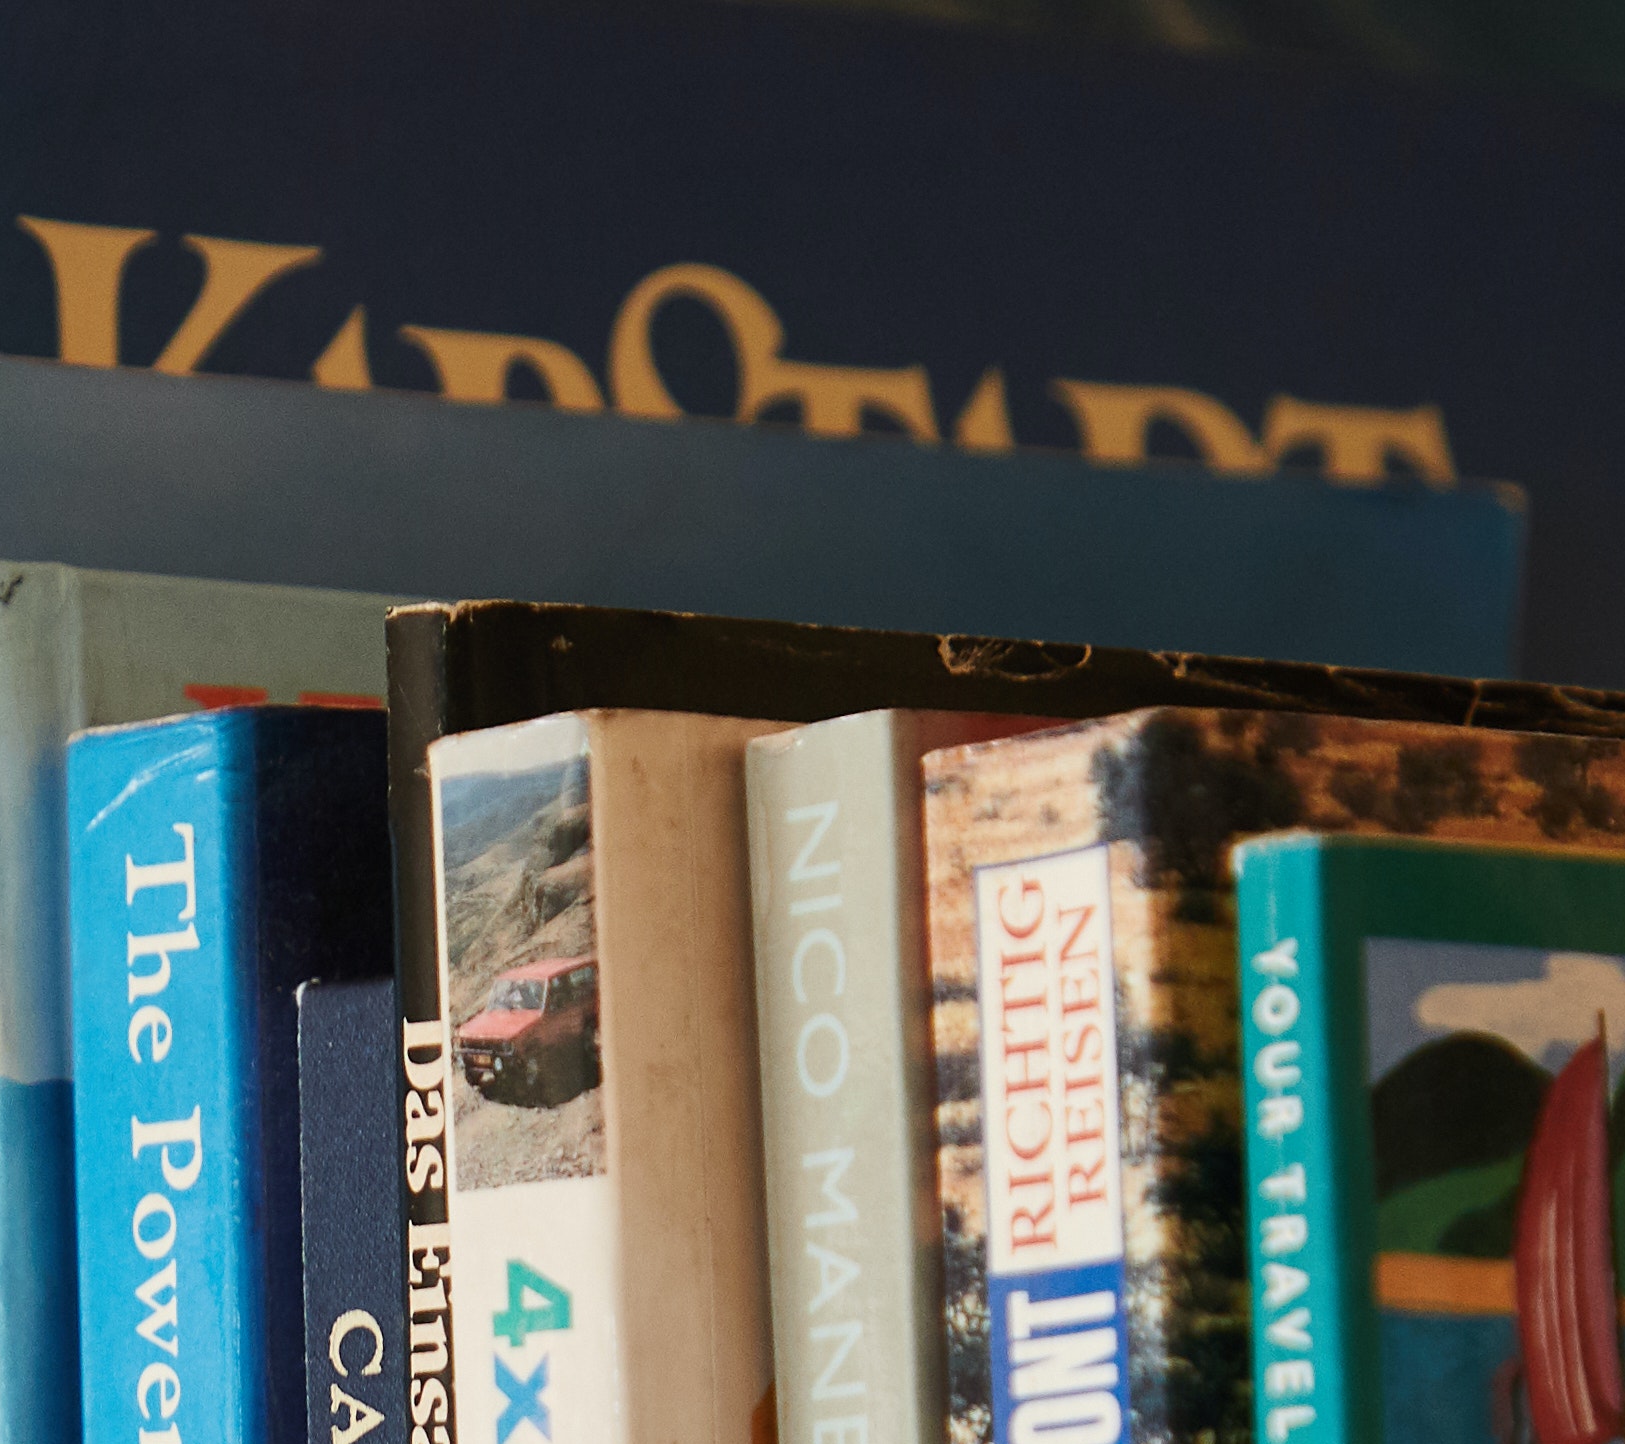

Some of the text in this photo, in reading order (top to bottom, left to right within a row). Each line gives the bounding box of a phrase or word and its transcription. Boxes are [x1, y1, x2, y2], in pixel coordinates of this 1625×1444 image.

[127, 820, 202, 1066] The
[786, 801, 847, 1098] NICO
[999, 878, 1056, 1253] RICHTIG
[1061, 904, 1107, 1208] REISEN
[1252, 937, 1302, 1138] YOUR
[403, 1016, 445, 1193] Das
[1260, 1162, 1315, 1444] TRAVEL
